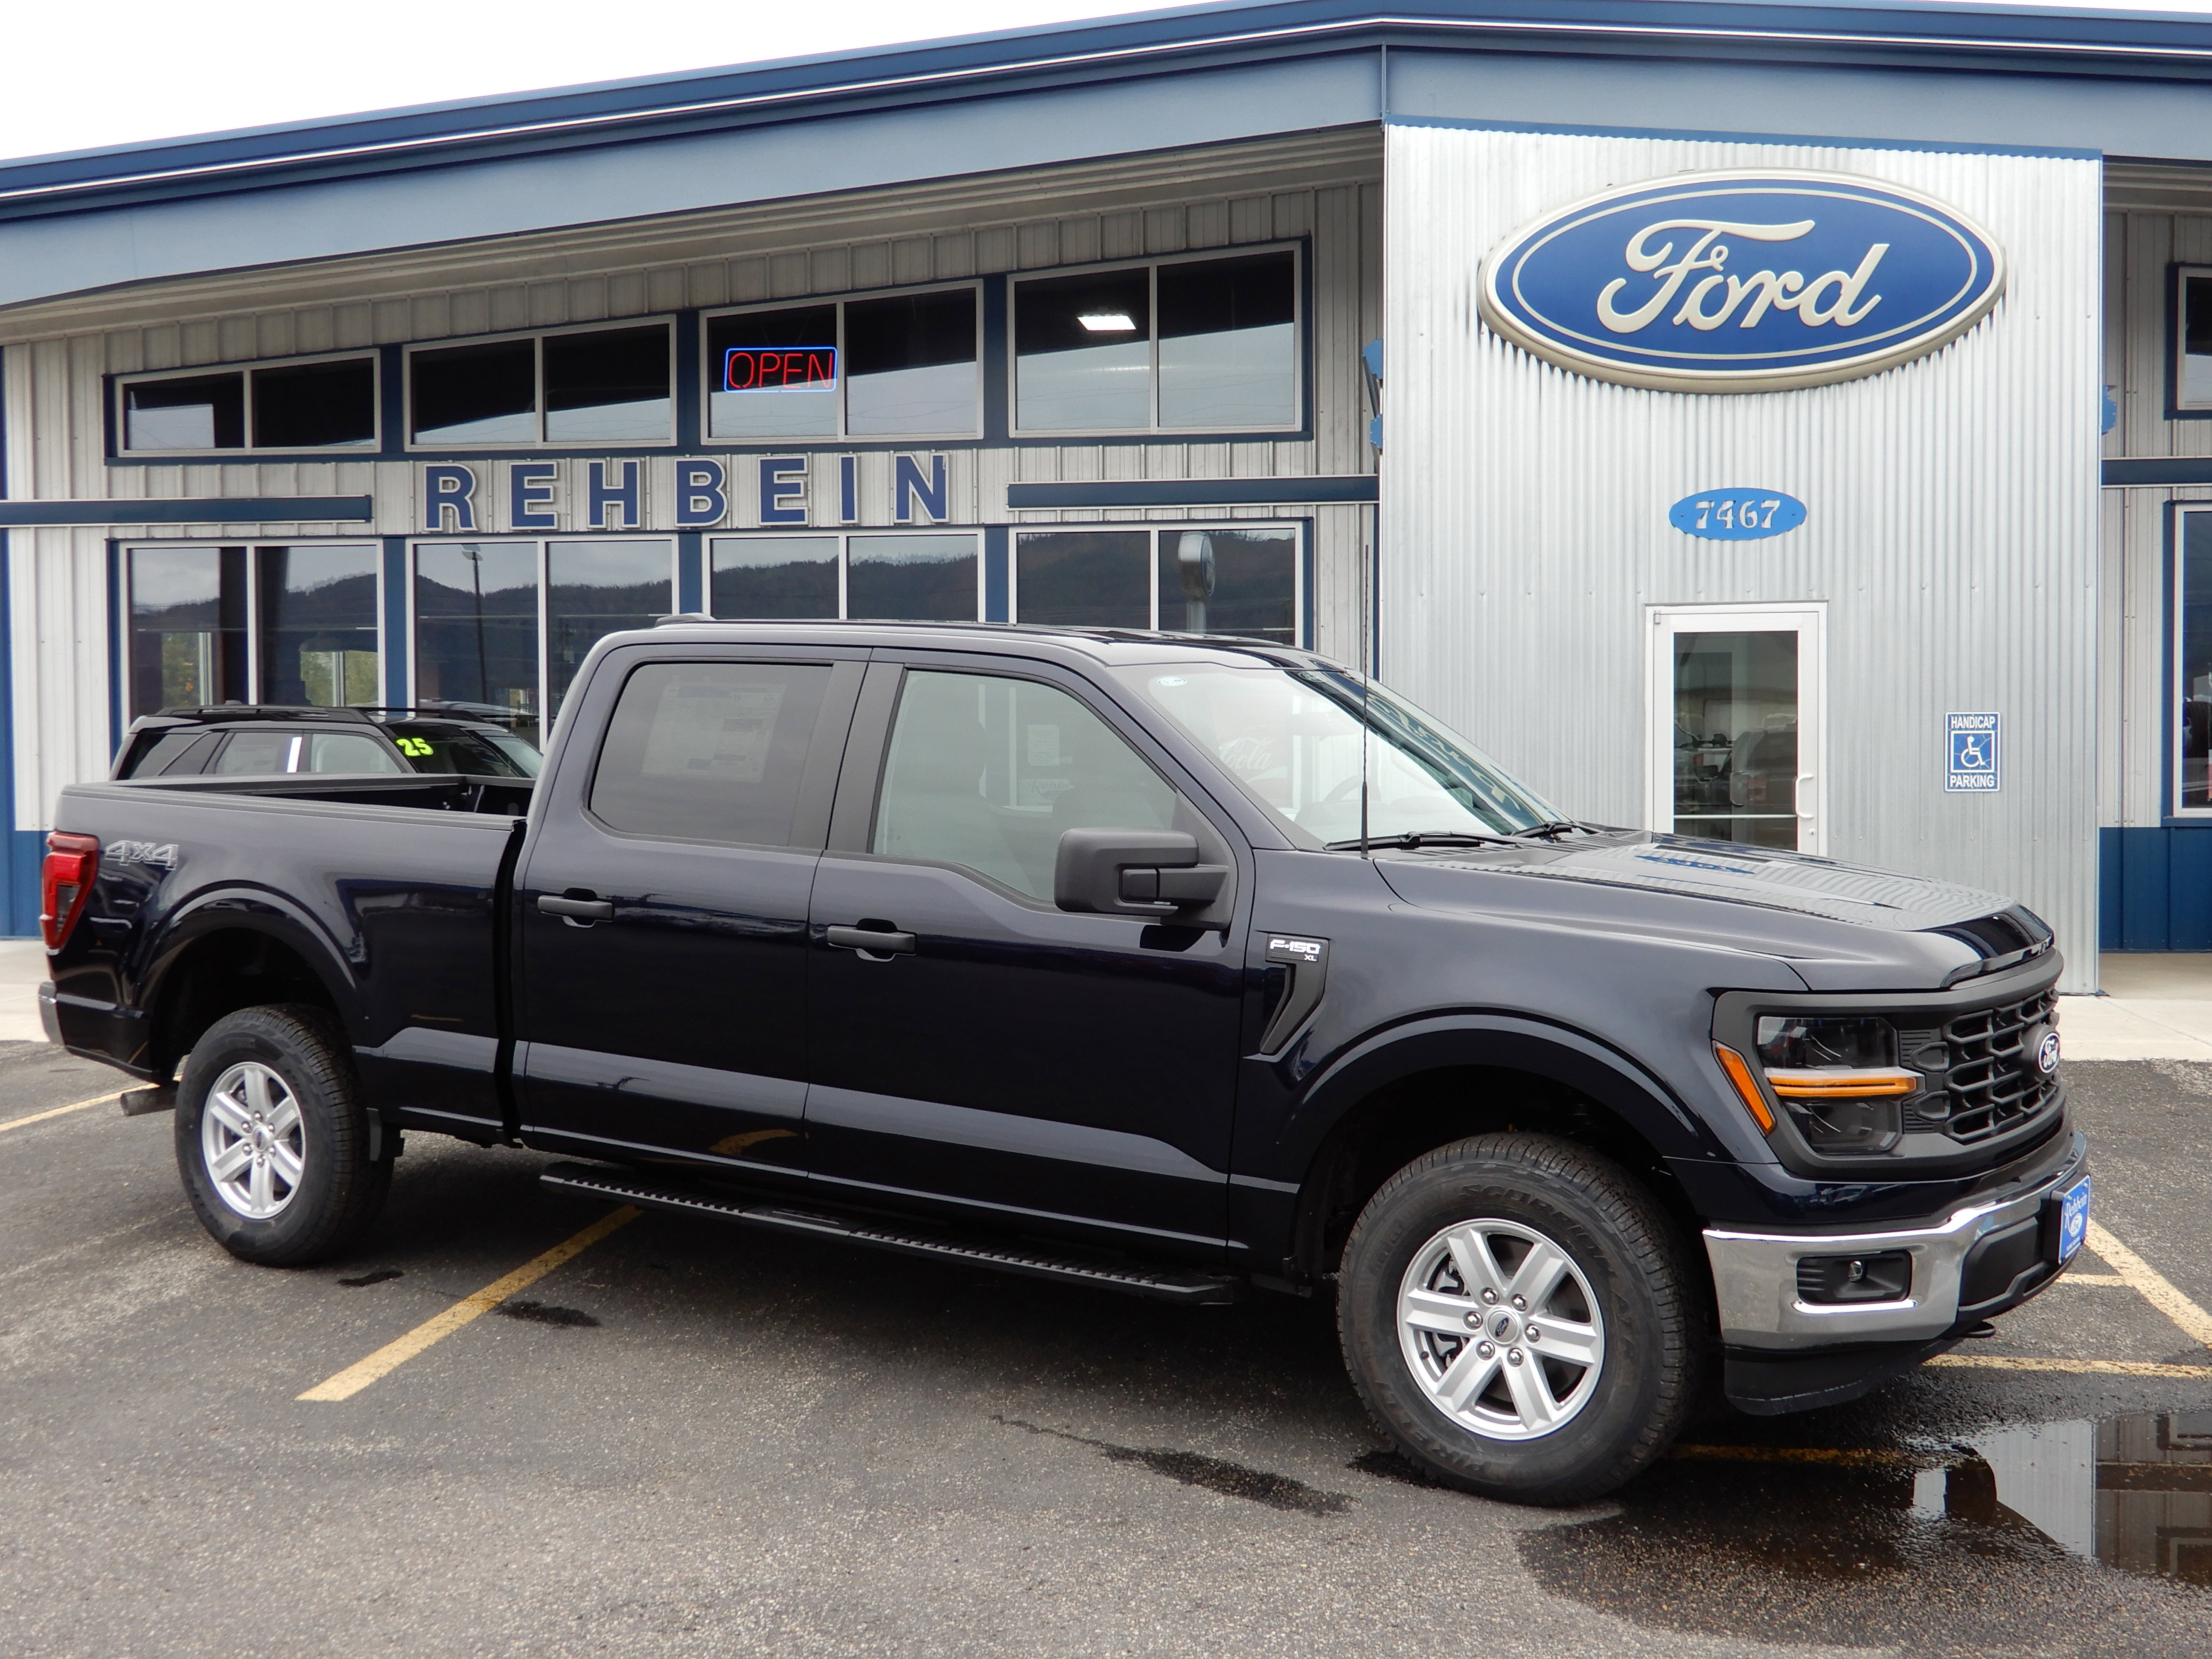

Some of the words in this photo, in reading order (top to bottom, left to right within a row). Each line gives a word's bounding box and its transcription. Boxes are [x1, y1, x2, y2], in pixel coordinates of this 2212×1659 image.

[1597, 219, 1891, 334] Ford
[728, 352, 833, 389] OPEN
[424, 452, 950, 533] REHBEIN
[1695, 500, 1781, 530] 7467
[1951, 716, 1996, 729] HANDICAP
[396, 738, 434, 757] 25
[1219, 737, 1277, 770] Cola
[1950, 774, 1995, 788] PARKING
[1269, 939, 1321, 955] F-150
[1497, 1319, 1508, 1335] Ford
